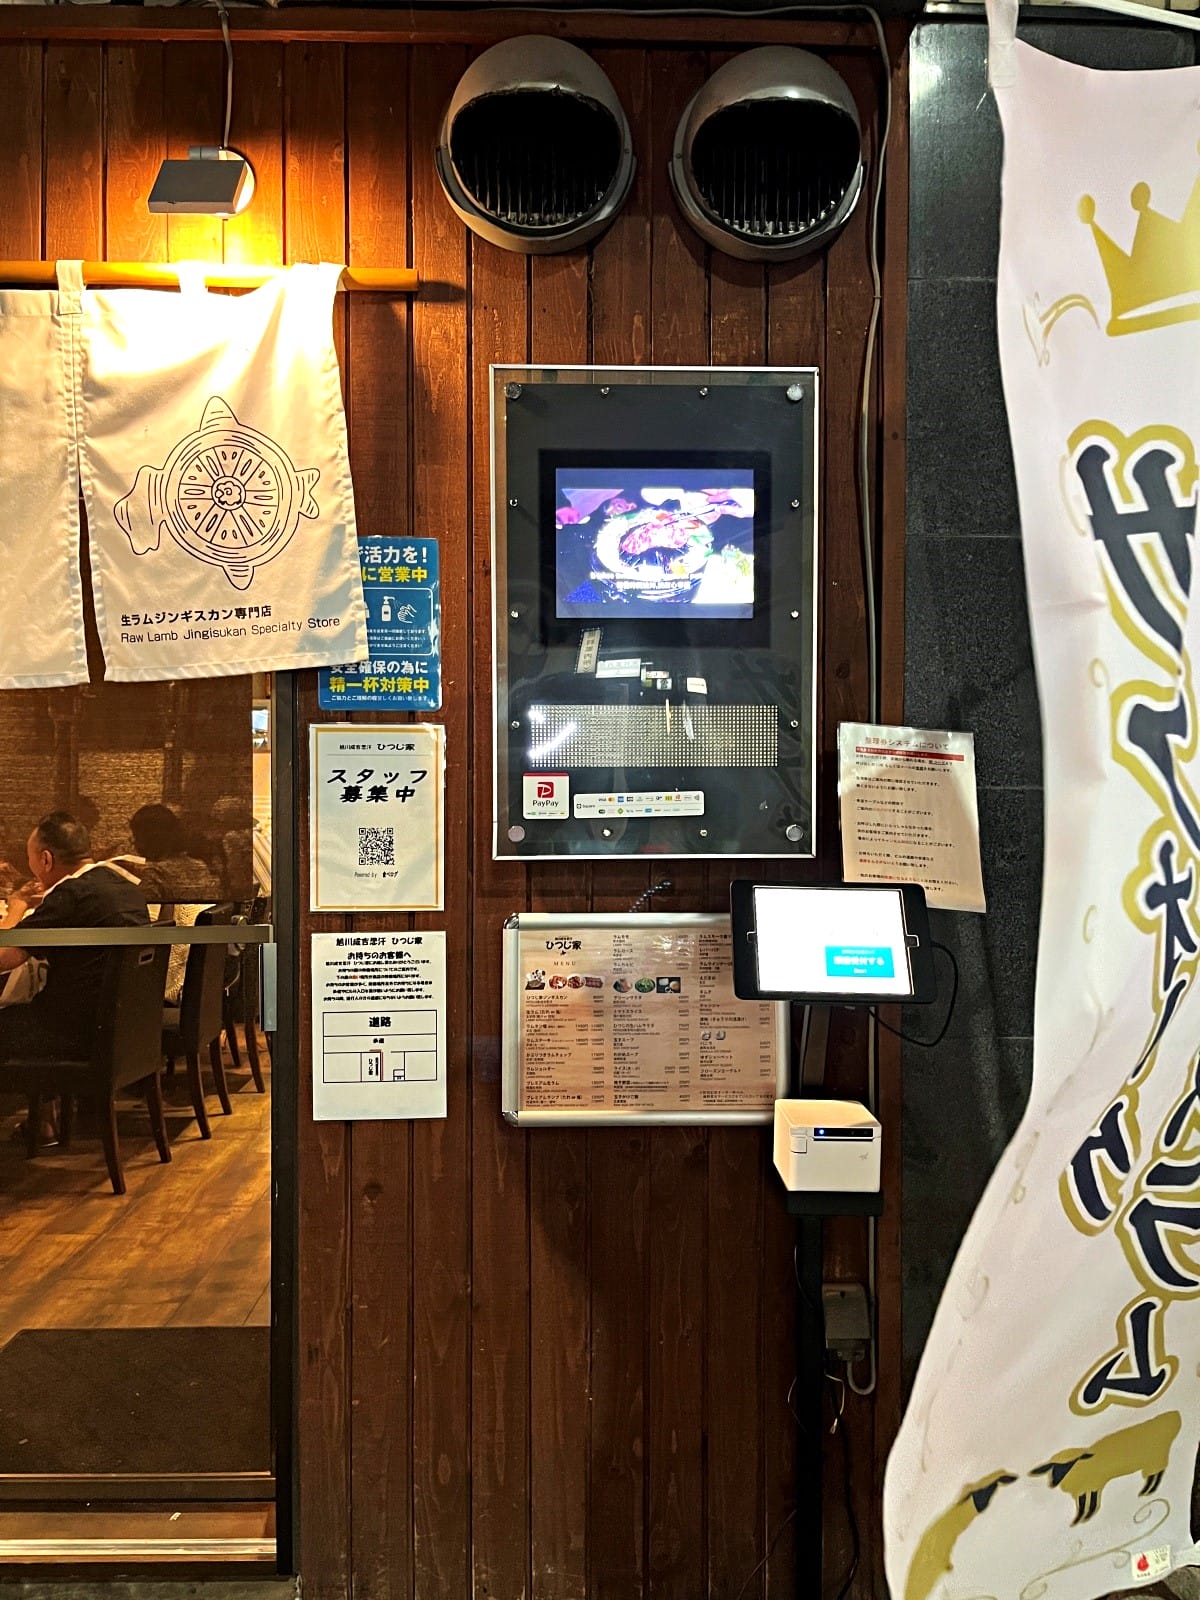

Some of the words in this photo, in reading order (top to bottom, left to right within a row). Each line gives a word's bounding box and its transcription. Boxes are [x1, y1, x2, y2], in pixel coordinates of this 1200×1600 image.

[121, 605, 272, 626] 生ラムジンギスカン専門店
[121, 632, 144, 643] Raw
[147, 631, 178, 642] Lamb
[183, 626, 247, 640] Jingisukan
[251, 620, 303, 635] Specialty
[307, 617, 340, 629] Store
[329, 676, 430, 693] 精一杯対策中
[377, 743, 415, 751] ひつじ家
[327, 768, 428, 784] スタッフ
[339, 785, 416, 803] 募集中
[532, 799, 559, 807] PayPay
[391, 936, 423, 945] ひつじ家
[545, 940, 582, 950] ひつじ家
